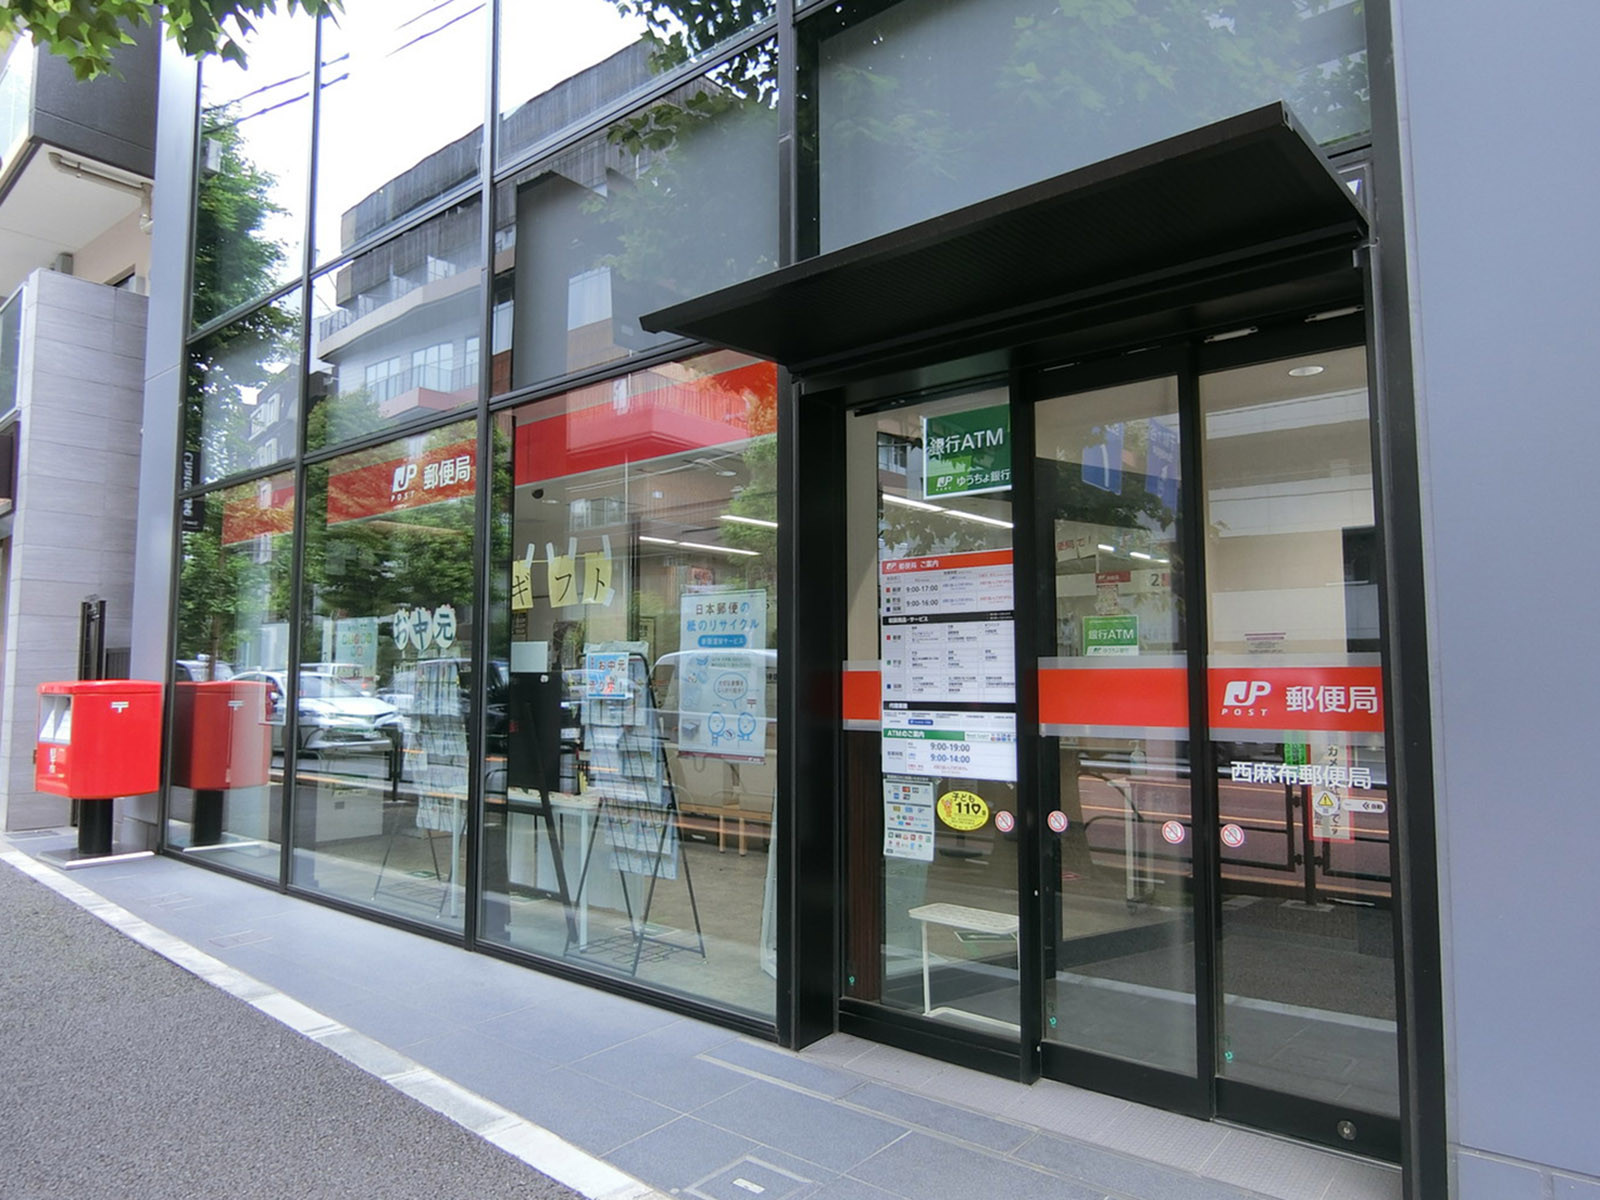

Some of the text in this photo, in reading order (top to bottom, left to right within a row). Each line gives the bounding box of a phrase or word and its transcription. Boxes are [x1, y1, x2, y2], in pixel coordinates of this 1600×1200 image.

[928, 427, 1003, 457] 銀行ATM
[392, 455, 471, 492] JP 郵便局
[956, 469, 1011, 487] ゆうちょ銀行
[390, 490, 416, 502] POST
[512, 567, 606, 606] ギフト
[1151, 573, 1160, 587] 2
[906, 585, 939, 593] 9:00-17:00
[695, 602, 750, 616] 日本郵便の
[394, 611, 454, 651] お中元
[687, 618, 760, 633] 紙のリサイクル
[1223, 680, 1378, 714] JP 郵便局
[1221, 708, 1269, 716] POST
[930, 742, 971, 752] 9:00-19:00
[930, 753, 971, 764] 9:00-14:00
[1230, 761, 1372, 790] 西麻布郵便局
[952, 792, 976, 804] 子ども
